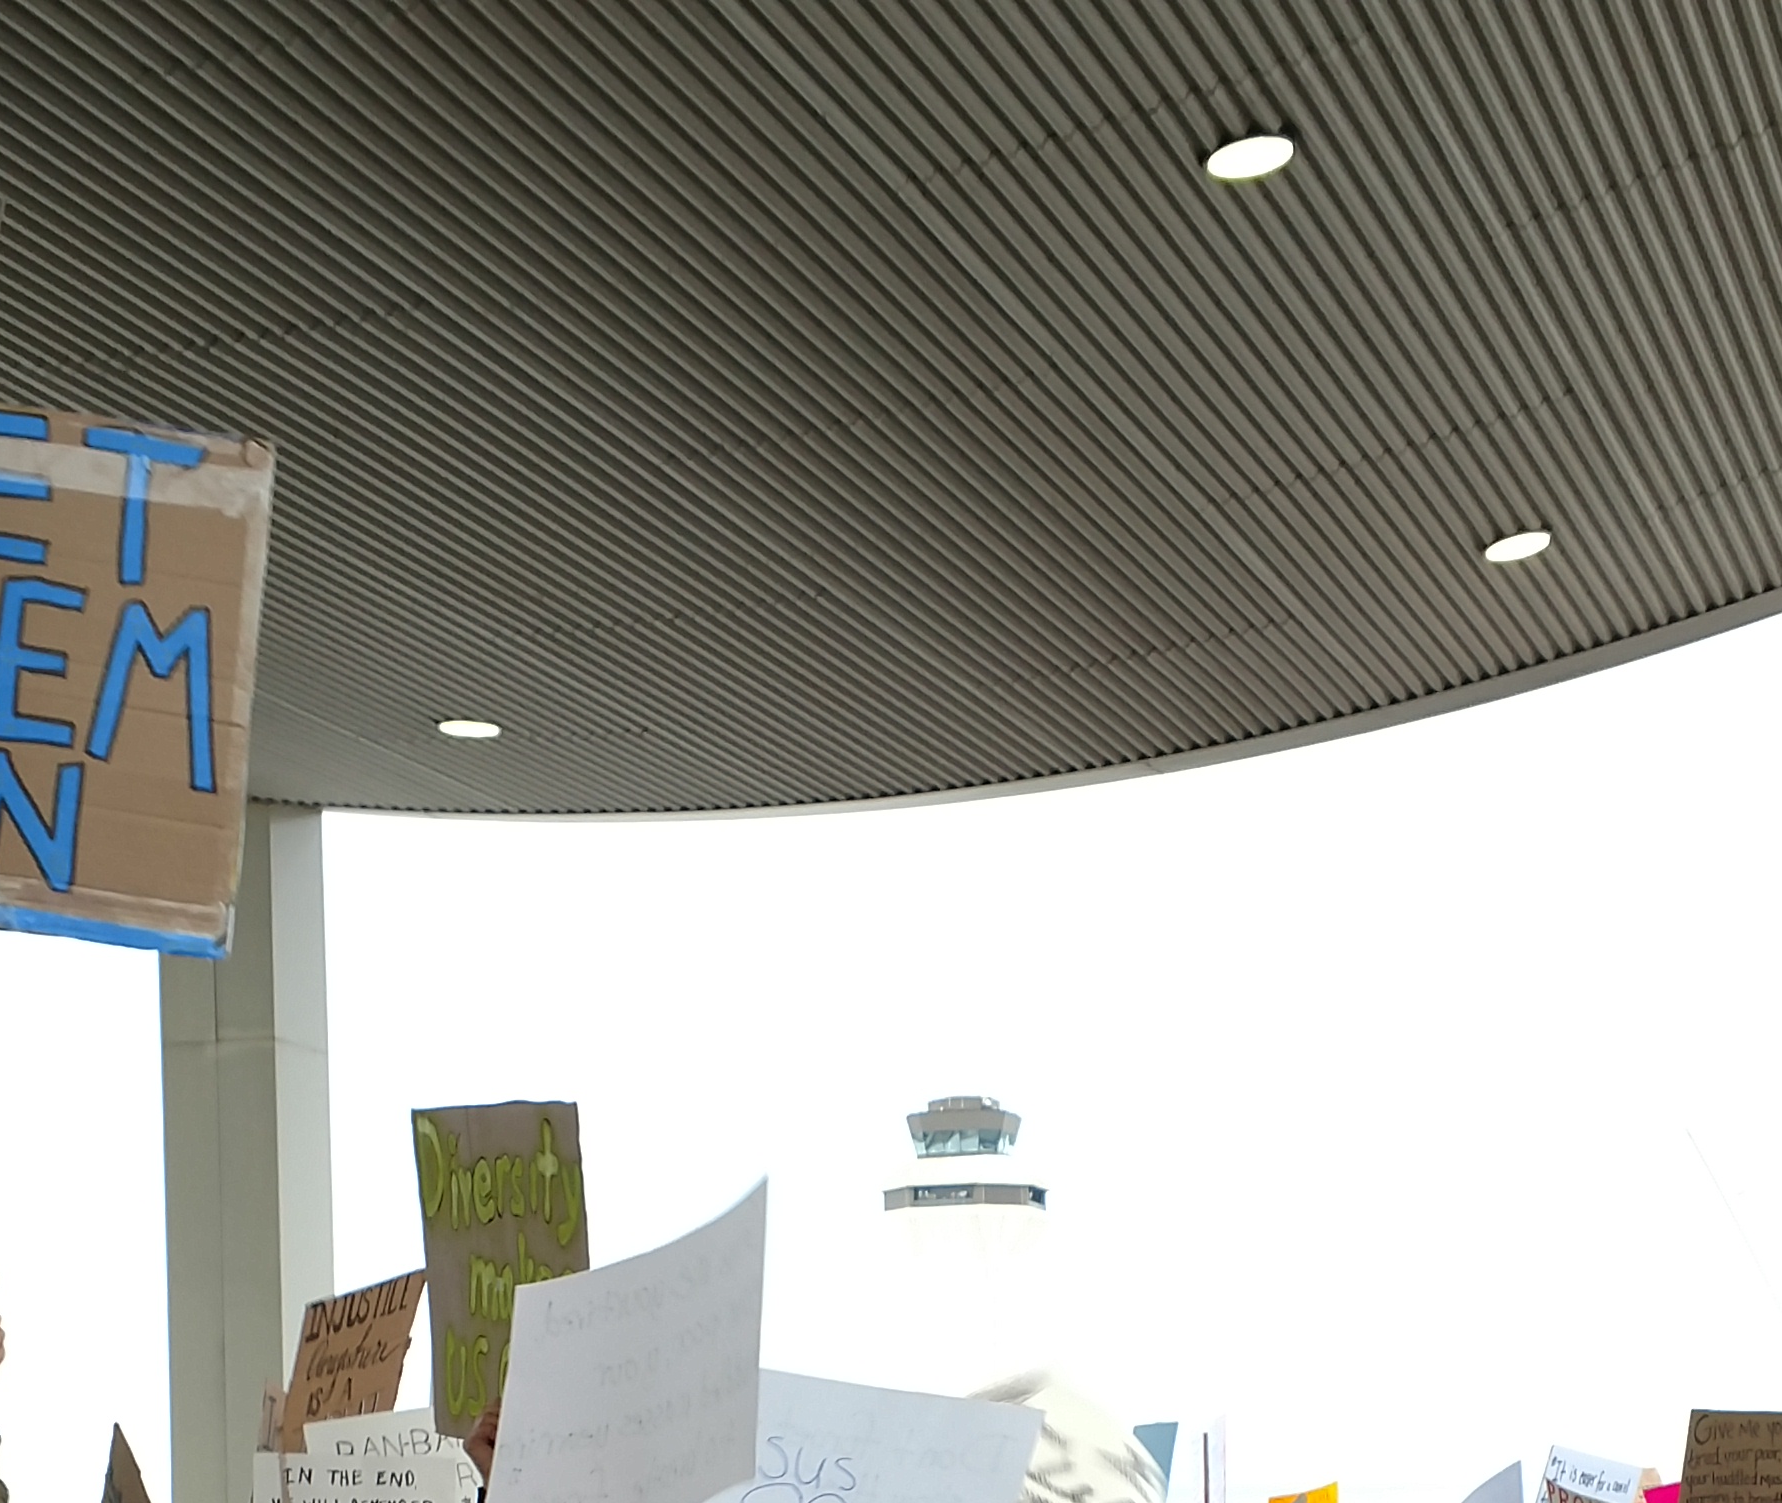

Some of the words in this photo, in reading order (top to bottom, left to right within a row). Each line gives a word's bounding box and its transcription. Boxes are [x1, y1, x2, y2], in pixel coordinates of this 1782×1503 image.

[416, 1115, 580, 1248] Diversity
[283, 1467, 312, 1485] IN
[328, 1468, 363, 1487] THE
